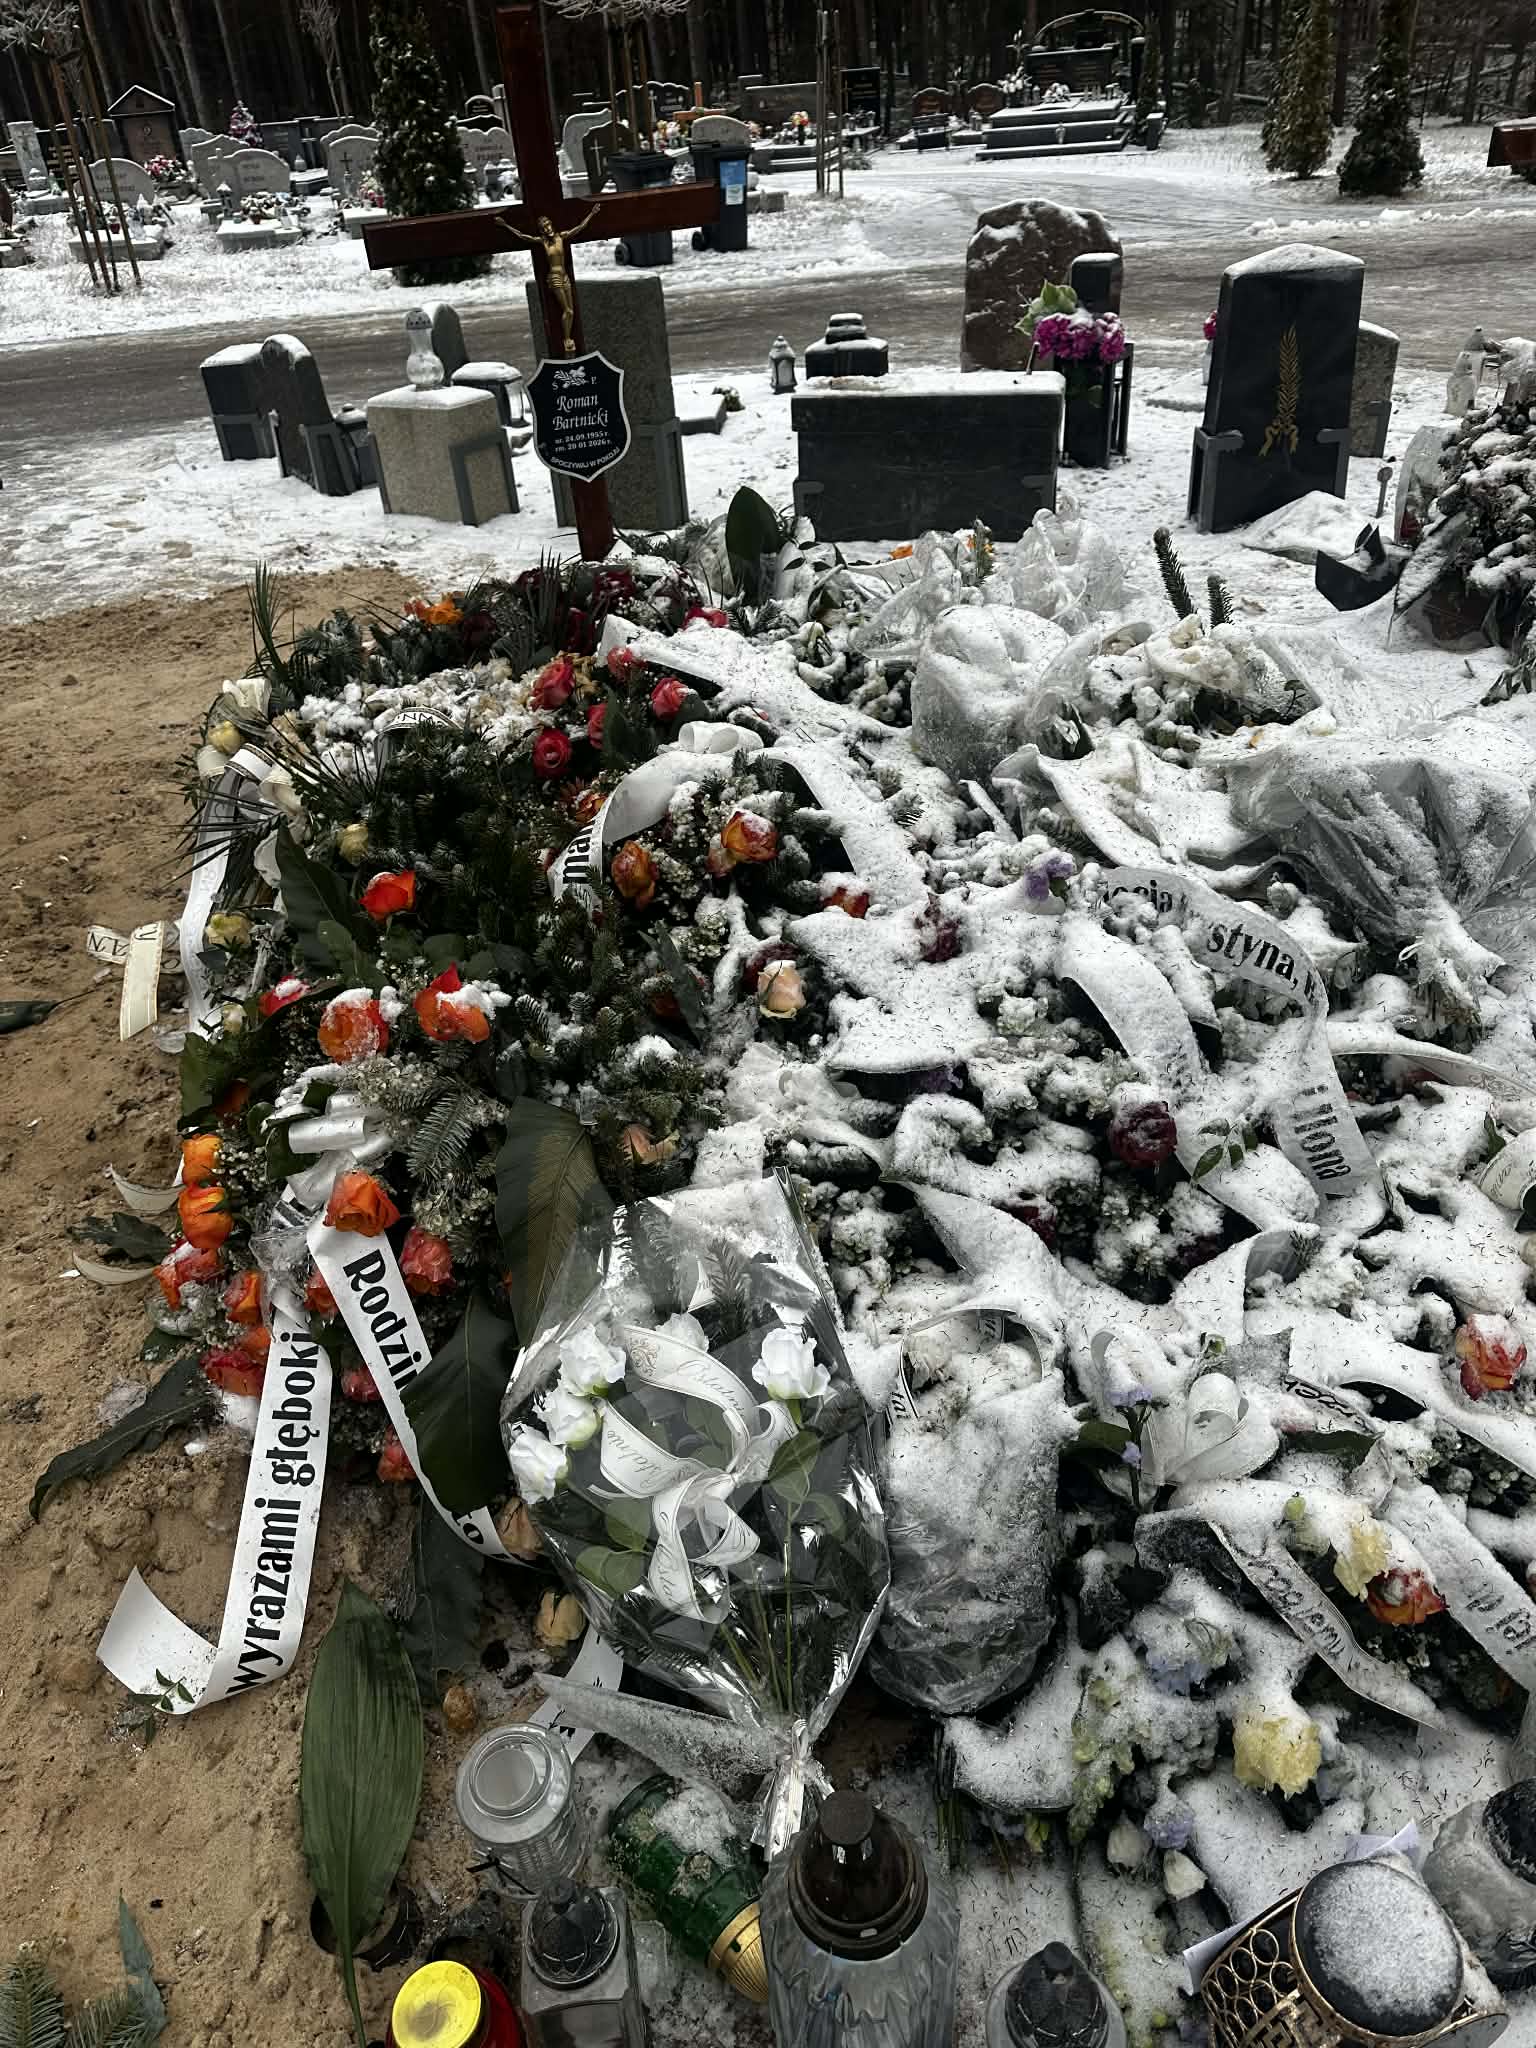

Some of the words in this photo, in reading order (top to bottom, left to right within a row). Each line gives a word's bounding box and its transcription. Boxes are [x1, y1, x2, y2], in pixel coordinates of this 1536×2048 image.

[556, 394, 598, 413] Roman
[552, 407, 608, 431] Bartnicki
[227, 1498, 302, 1695] wyrazami
